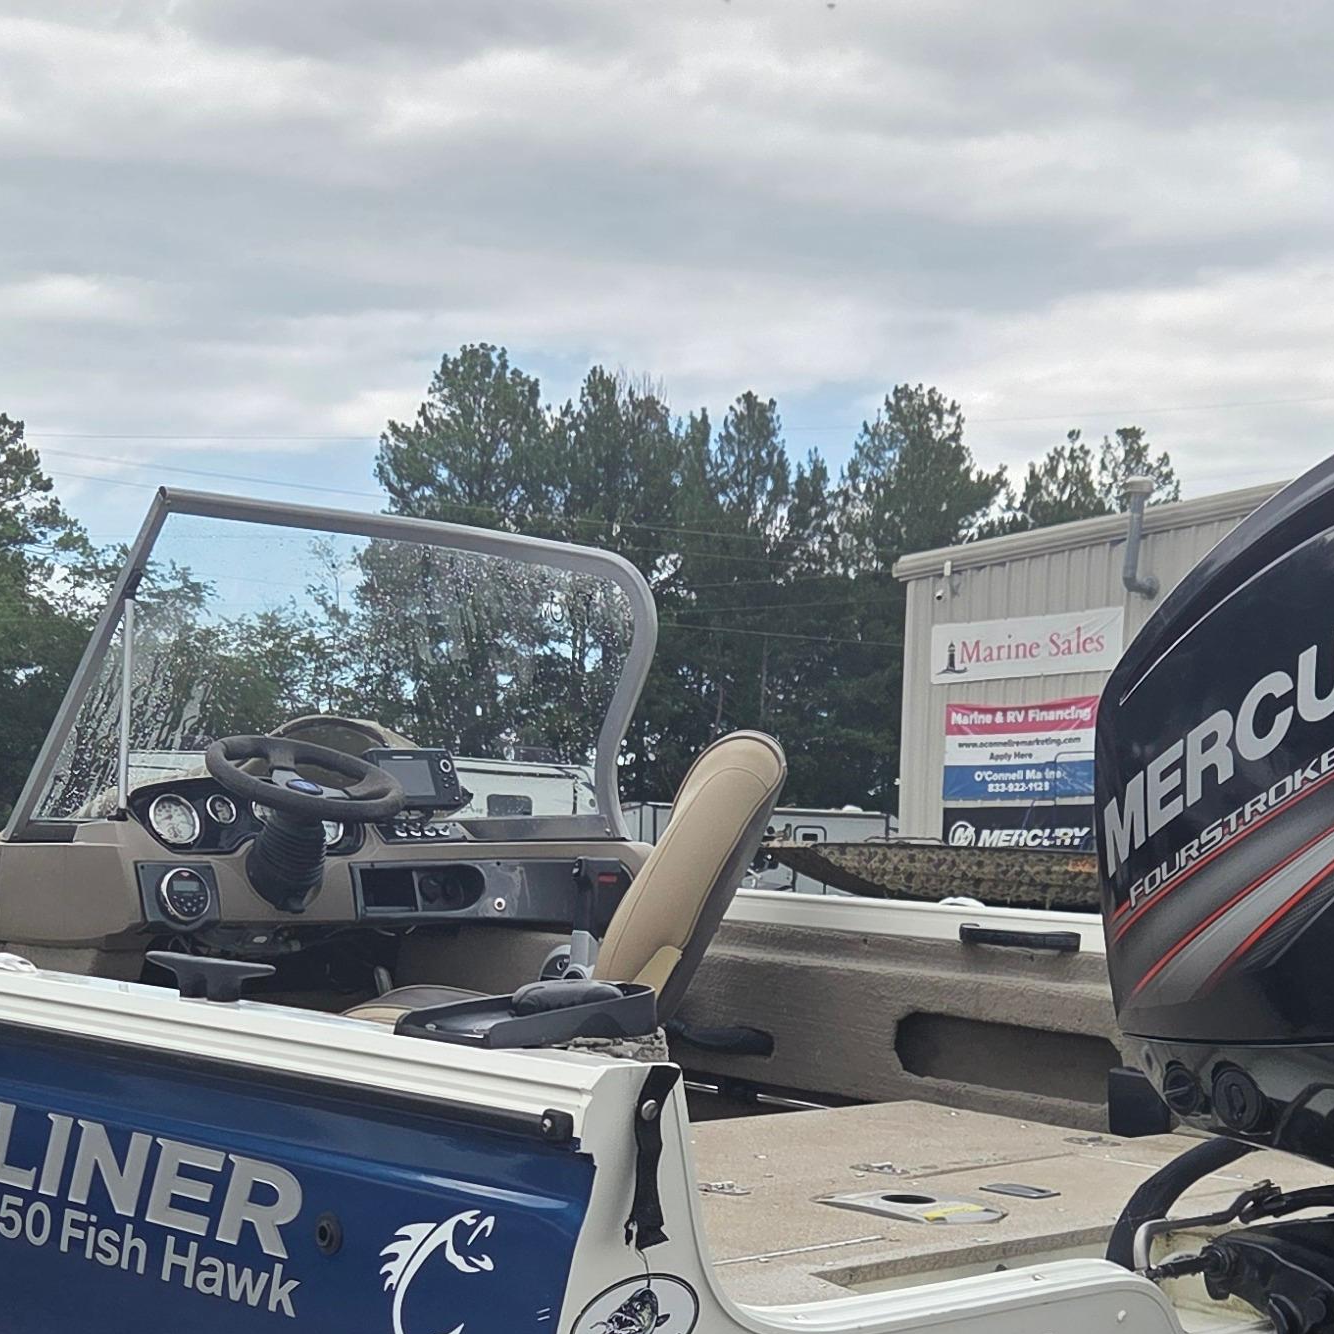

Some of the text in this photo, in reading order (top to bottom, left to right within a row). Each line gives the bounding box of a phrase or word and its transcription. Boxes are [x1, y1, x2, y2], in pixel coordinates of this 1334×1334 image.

[959, 626, 1105, 665] Marine Sales
[951, 706, 1092, 726] Marine & RV Financing
[989, 751, 1033, 762] Apply Here
[974, 769, 1024, 781] O'Connell
[59, 1207, 150, 1275] Fish
[161, 1235, 302, 1319] Hawk
